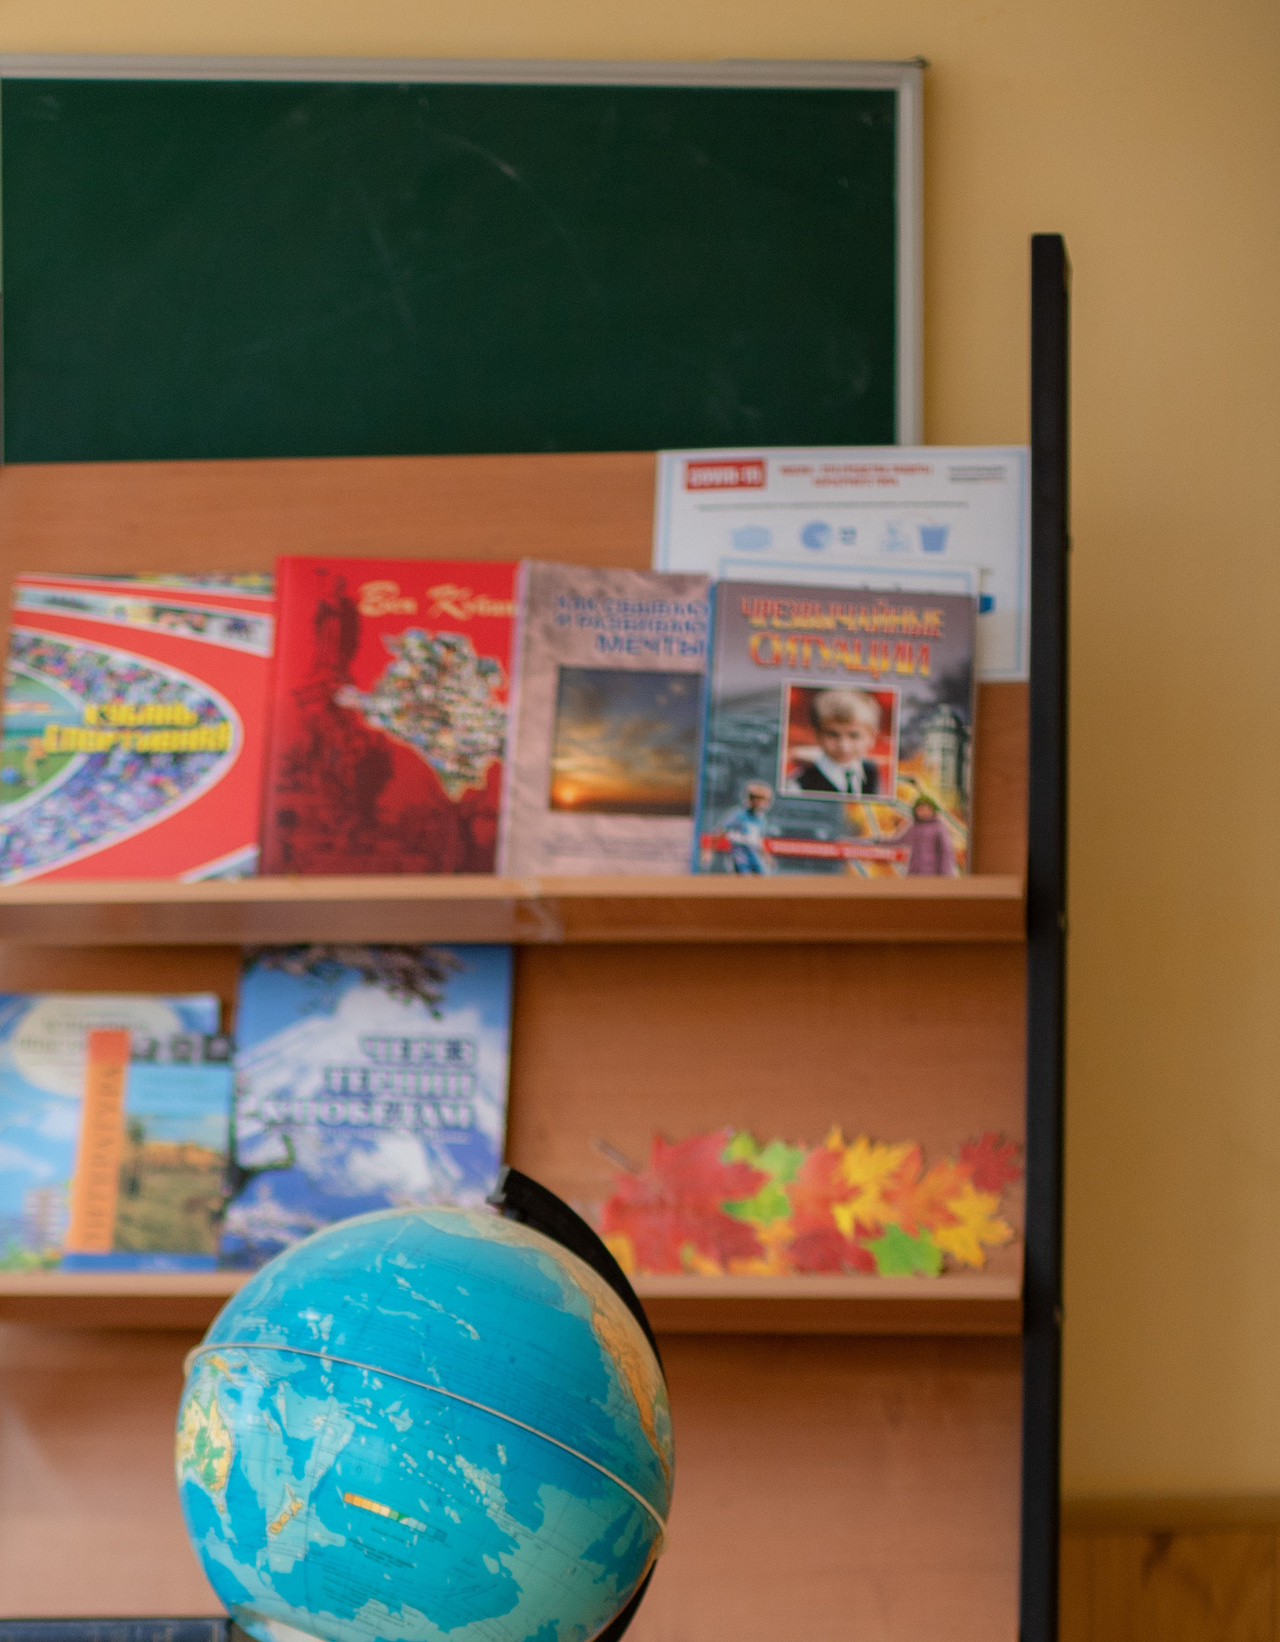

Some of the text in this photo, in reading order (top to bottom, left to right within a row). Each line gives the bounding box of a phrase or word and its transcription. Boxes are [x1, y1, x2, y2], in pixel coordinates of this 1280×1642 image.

[689, 465, 762, 487] COVID-19
[740, 597, 944, 638] ЧРЕЗВЫЧАЙНЫЕ
[596, 634, 704, 657] МЕЧТЫ
[748, 630, 932, 681] СИТУАЦИИ
